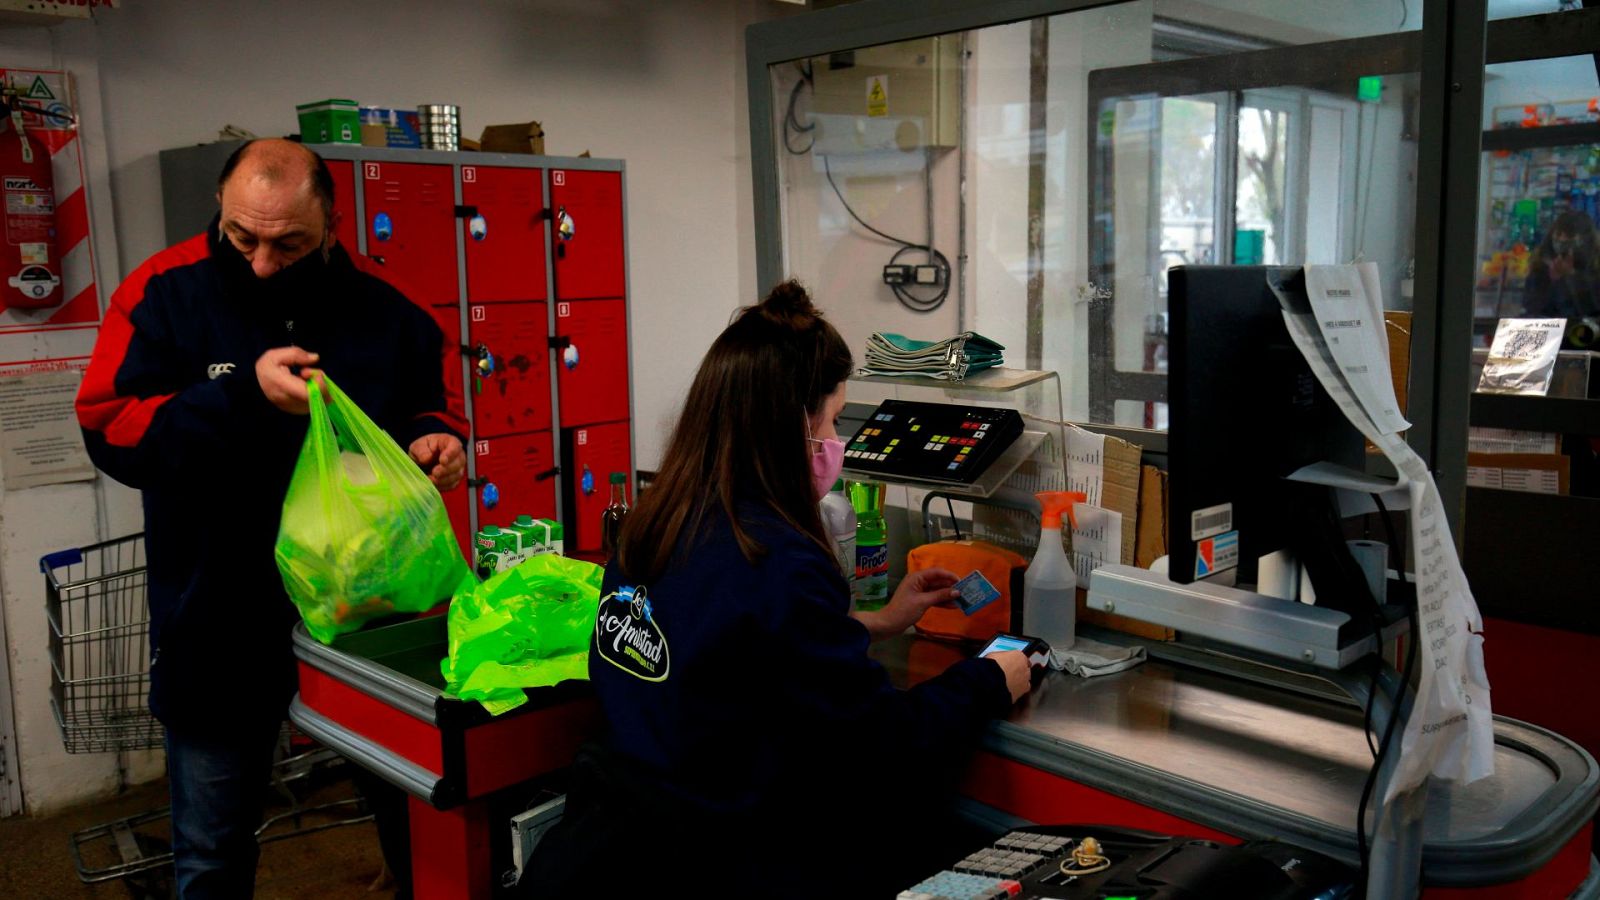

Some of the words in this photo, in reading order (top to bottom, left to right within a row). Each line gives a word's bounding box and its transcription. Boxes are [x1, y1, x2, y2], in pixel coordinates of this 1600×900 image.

[368, 166, 377, 177] 2
[465, 169, 473, 180] 3
[556, 173, 562, 183] 4
[475, 309, 482, 318] 7
[478, 443, 488, 453] 11
[606, 614, 663, 664] Amistad
